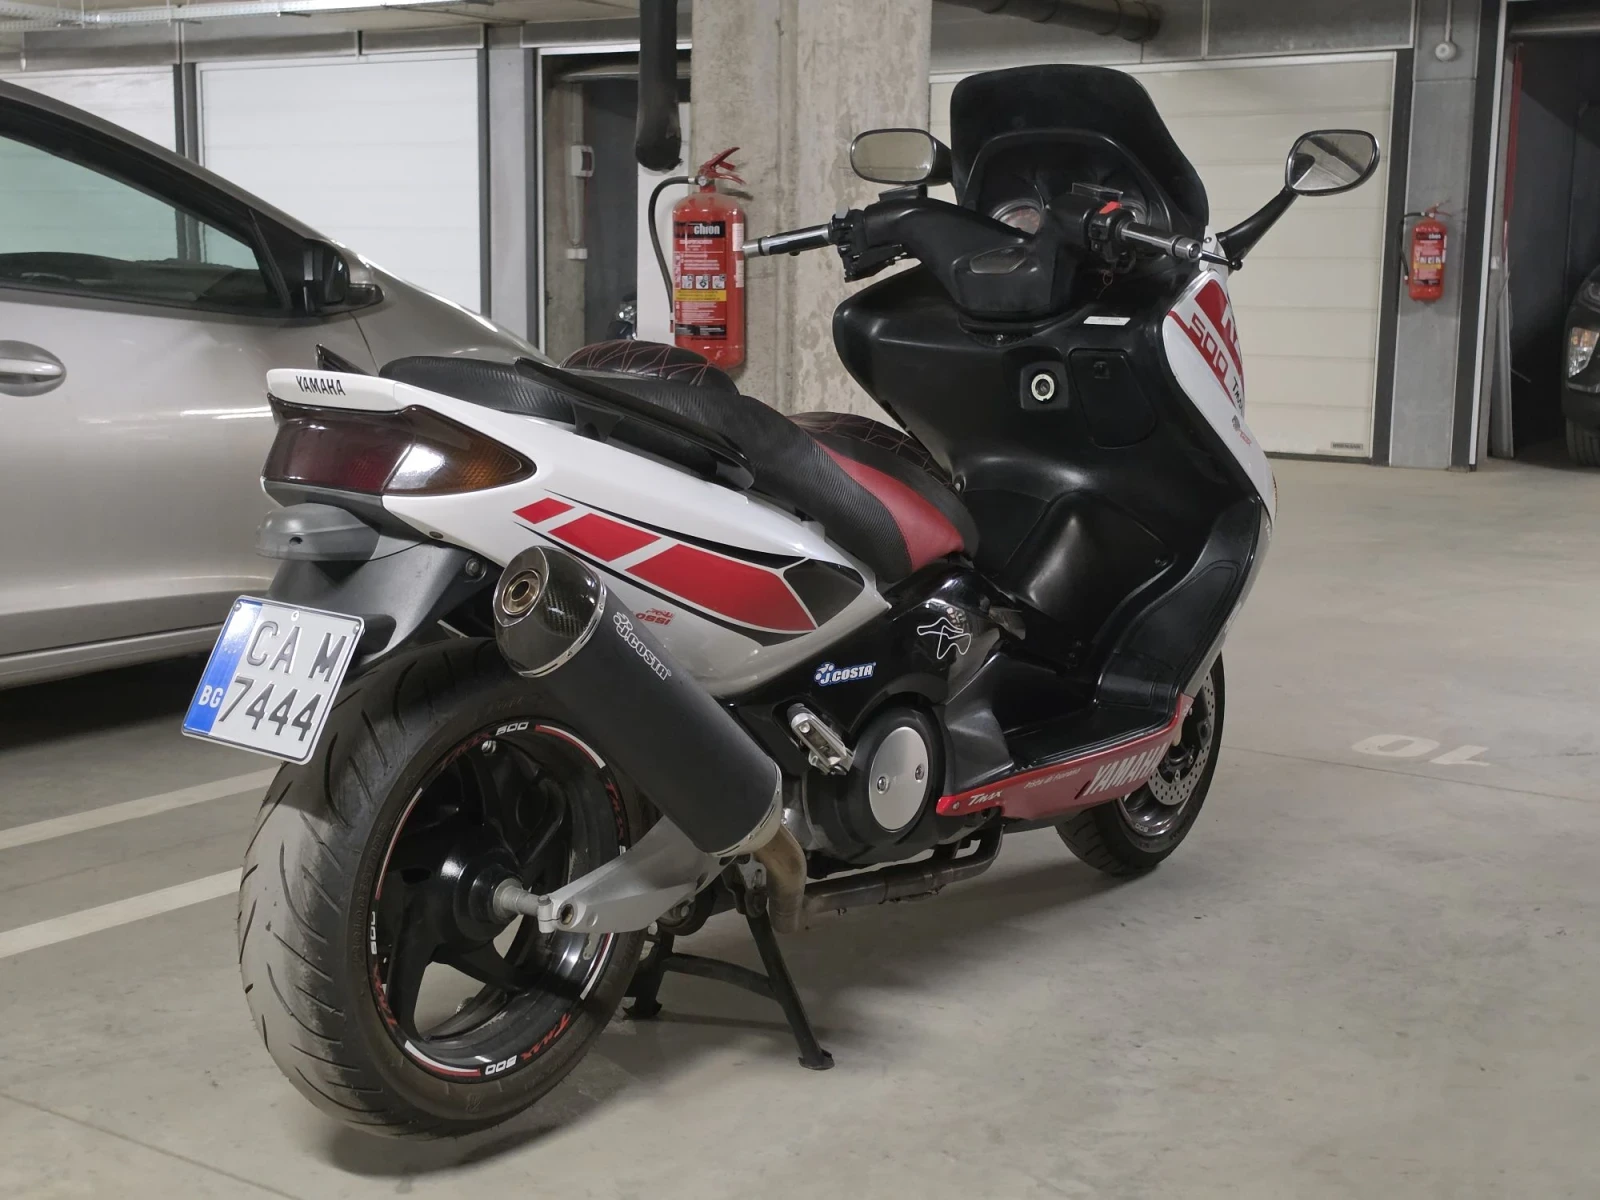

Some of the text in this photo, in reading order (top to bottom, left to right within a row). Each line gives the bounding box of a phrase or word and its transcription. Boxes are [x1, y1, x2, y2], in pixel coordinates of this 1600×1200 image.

[1191, 313, 1229, 381] 500
[296, 376, 346, 396] YAMAHA
[636, 613, 671, 625] OSSI
[247, 621, 347, 682] CA M
[820, 664, 873, 685] J.COSTA
[198, 685, 224, 708] BG
[219, 676, 322, 742] 7444
[495, 721, 529, 736] 500
[1081, 742, 1169, 797] YAMAHA
[485, 1055, 518, 1076] 500
